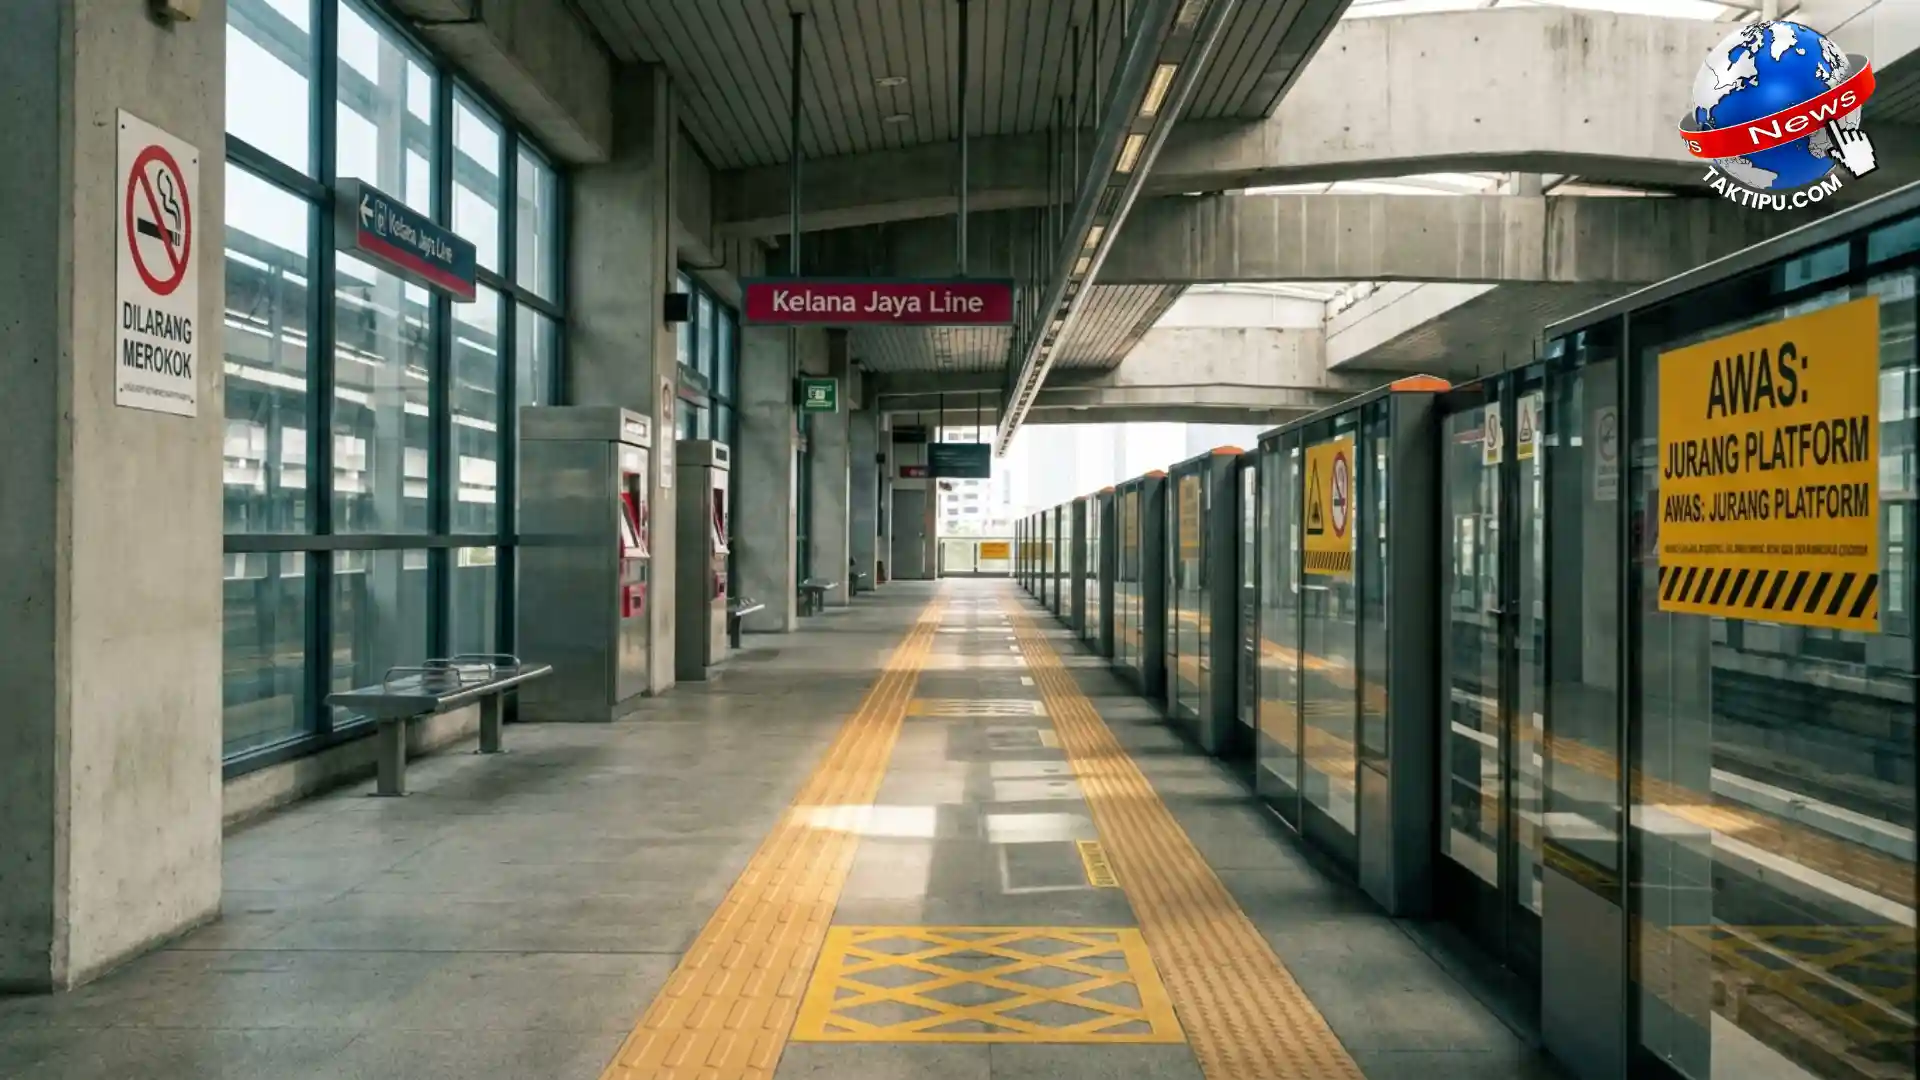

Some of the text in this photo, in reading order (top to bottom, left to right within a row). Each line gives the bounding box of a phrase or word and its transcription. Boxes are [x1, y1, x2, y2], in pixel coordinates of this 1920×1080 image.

[123, 301, 192, 345] DILARANG
[773, 290, 984, 317] Kelana Jaya Line
[123, 338, 192, 380] MEROKOK
[1707, 341, 1808, 419] AWAS:
[1664, 415, 1869, 480] JURANG PLATFORM
[1664, 483, 1869, 522] AWAS: JURANG PLATFORM
